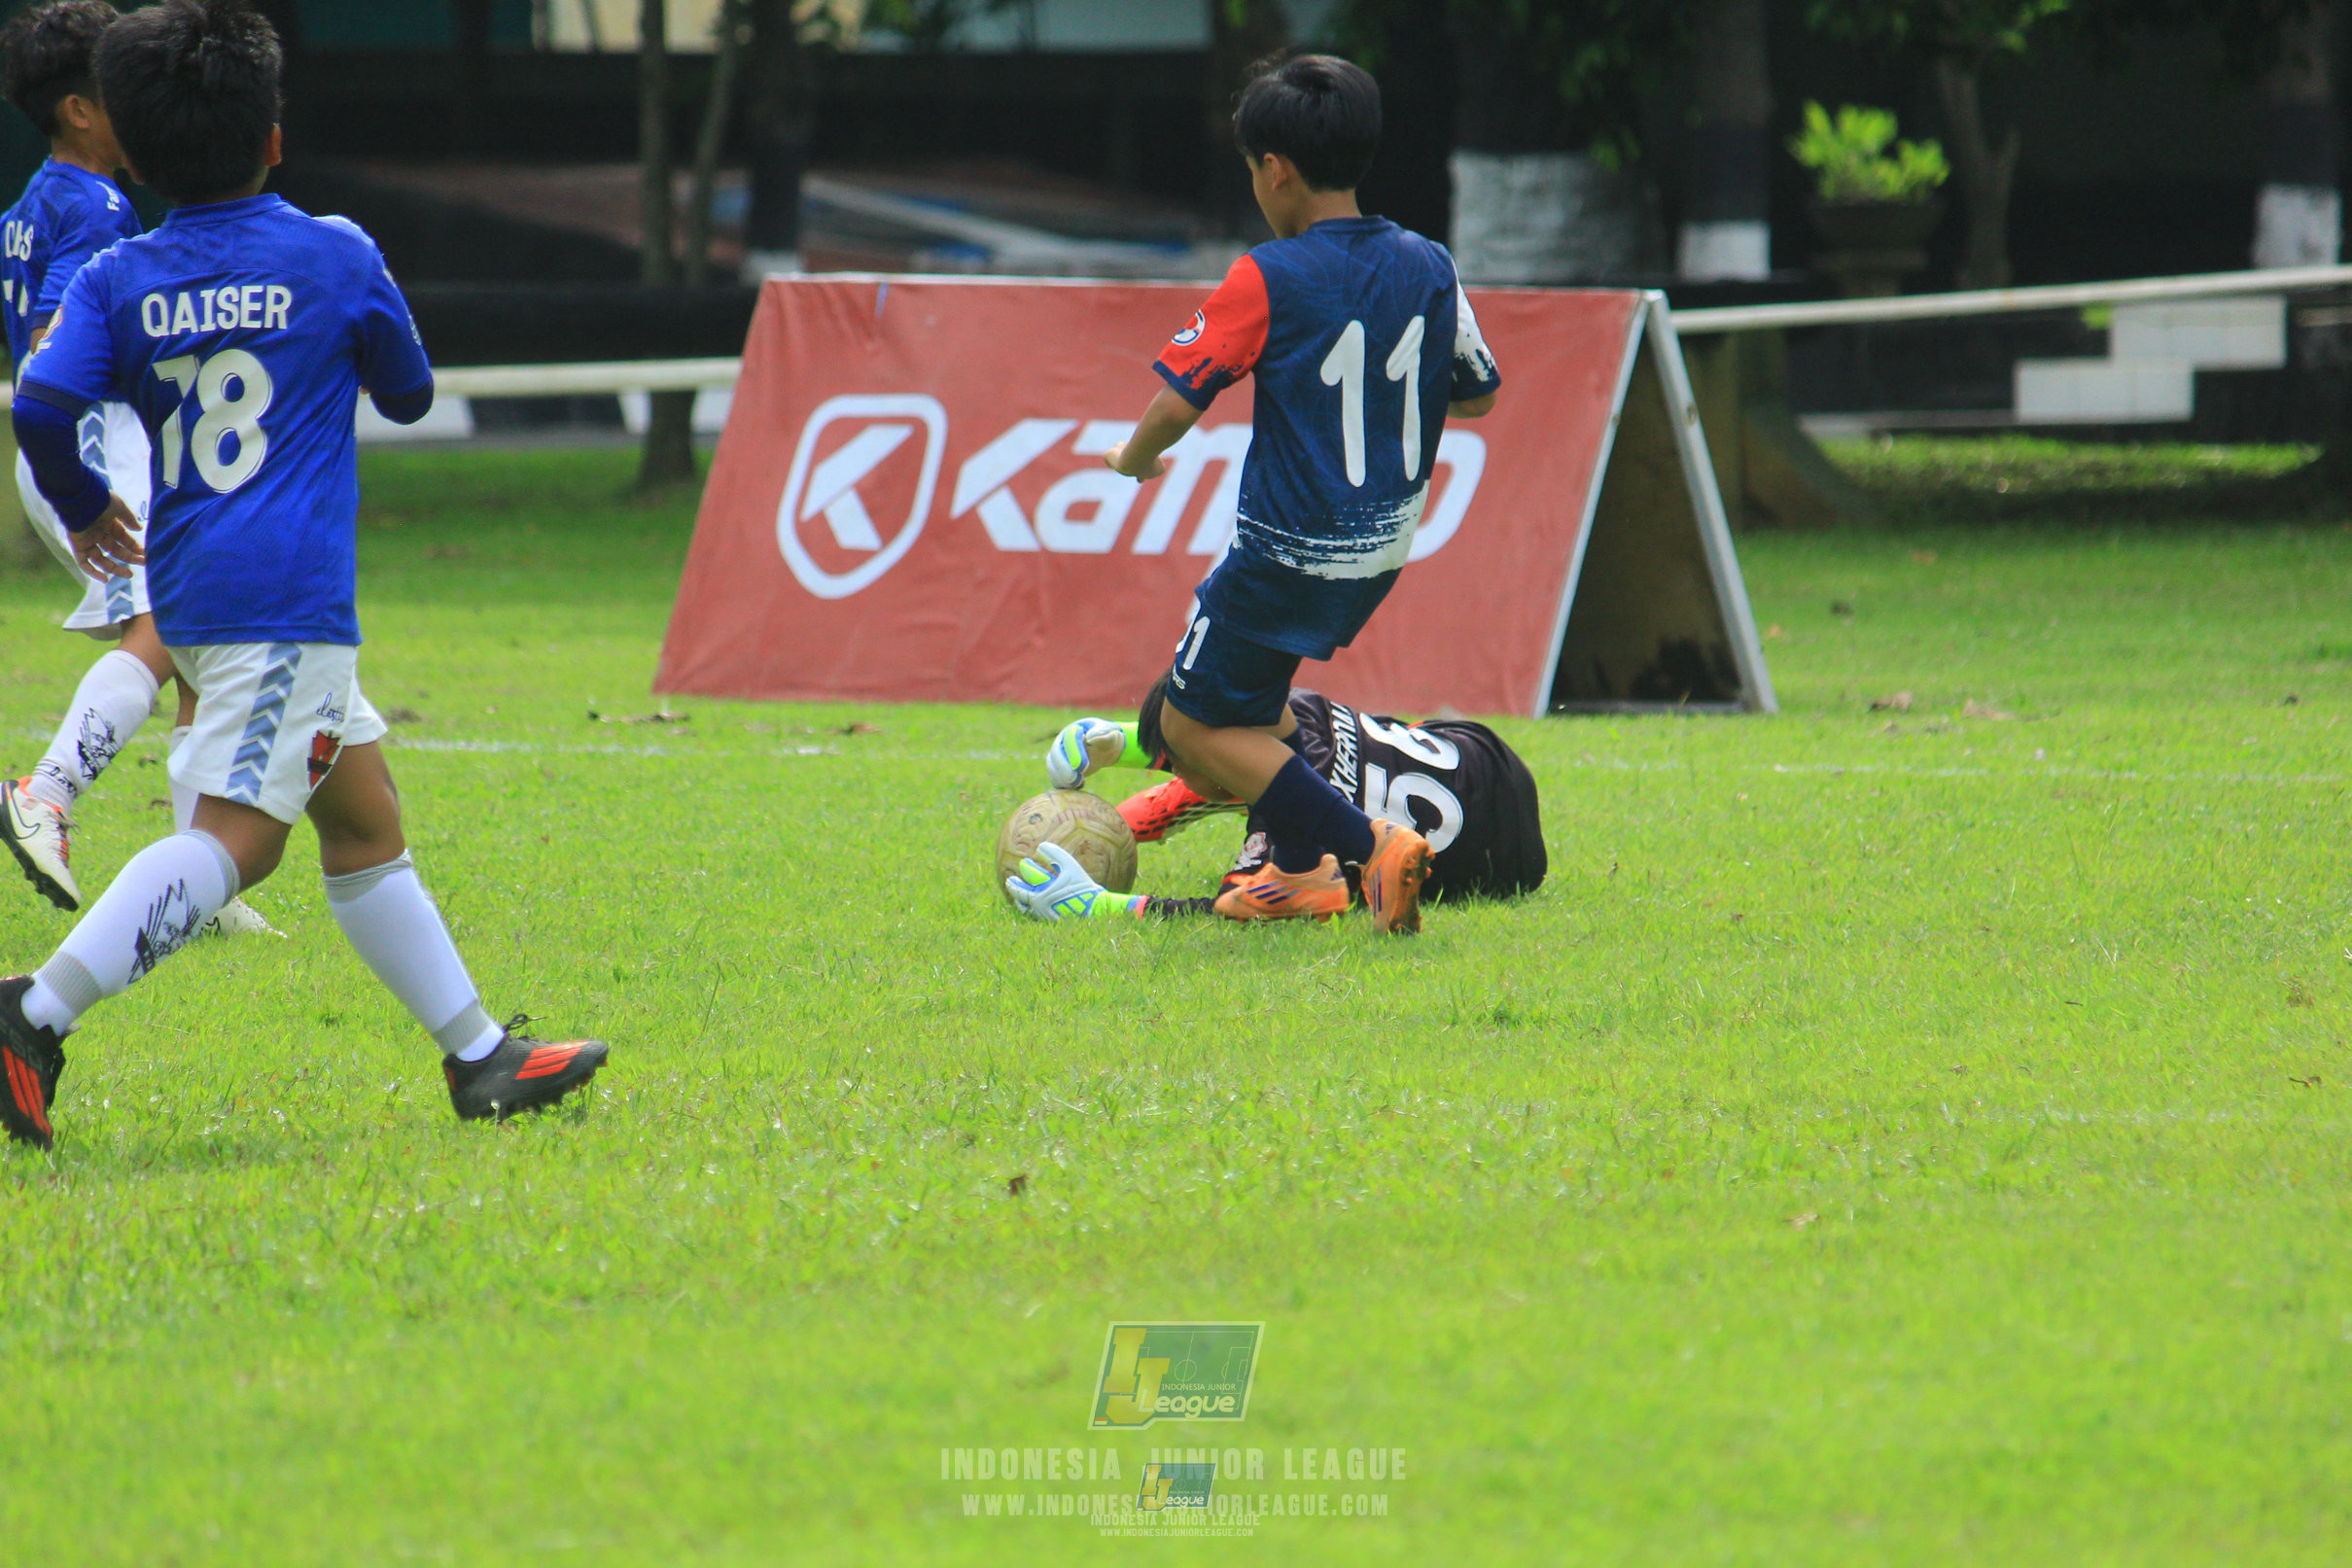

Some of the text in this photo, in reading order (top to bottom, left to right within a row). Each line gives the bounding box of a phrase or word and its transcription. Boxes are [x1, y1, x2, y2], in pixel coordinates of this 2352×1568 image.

[141, 285, 293, 337] QAISER
[152, 348, 274, 494] 18
[1319, 315, 1425, 487] 11
[1359, 712, 1463, 854] 56
